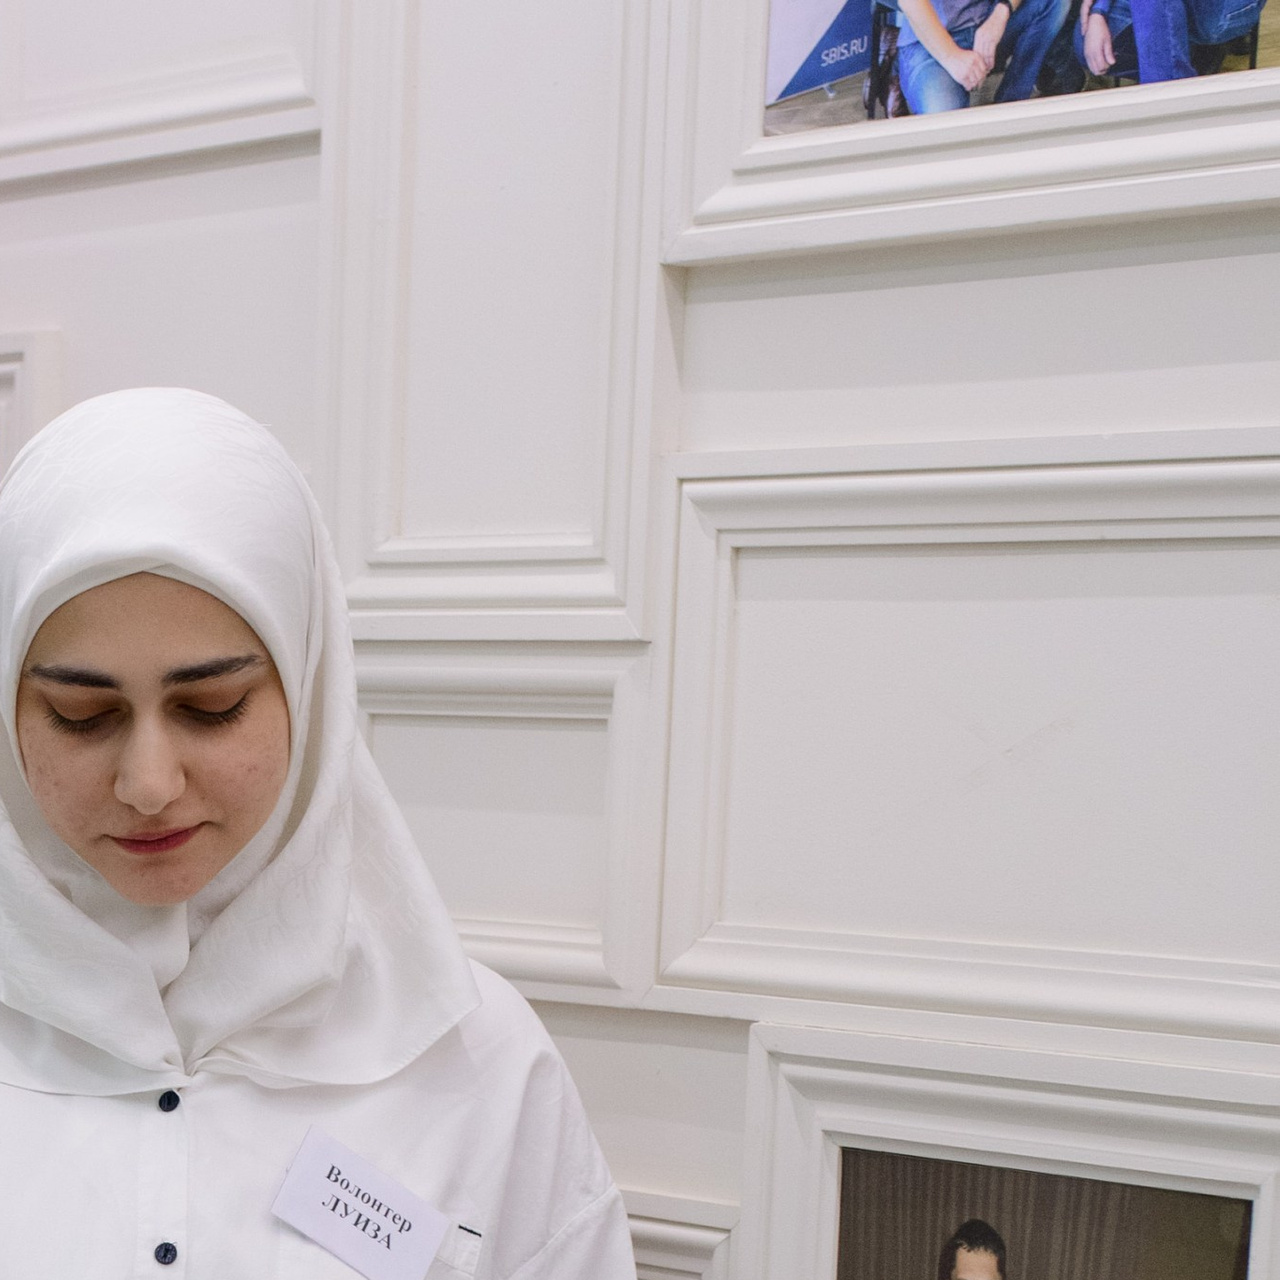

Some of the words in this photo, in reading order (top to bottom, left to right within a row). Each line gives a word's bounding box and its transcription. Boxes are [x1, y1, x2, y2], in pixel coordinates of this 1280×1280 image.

[820, 36, 869, 68] SBIS.RU
[321, 1193, 393, 1251] ЛУИЗА
[325, 1164, 413, 1234] Волонтер
